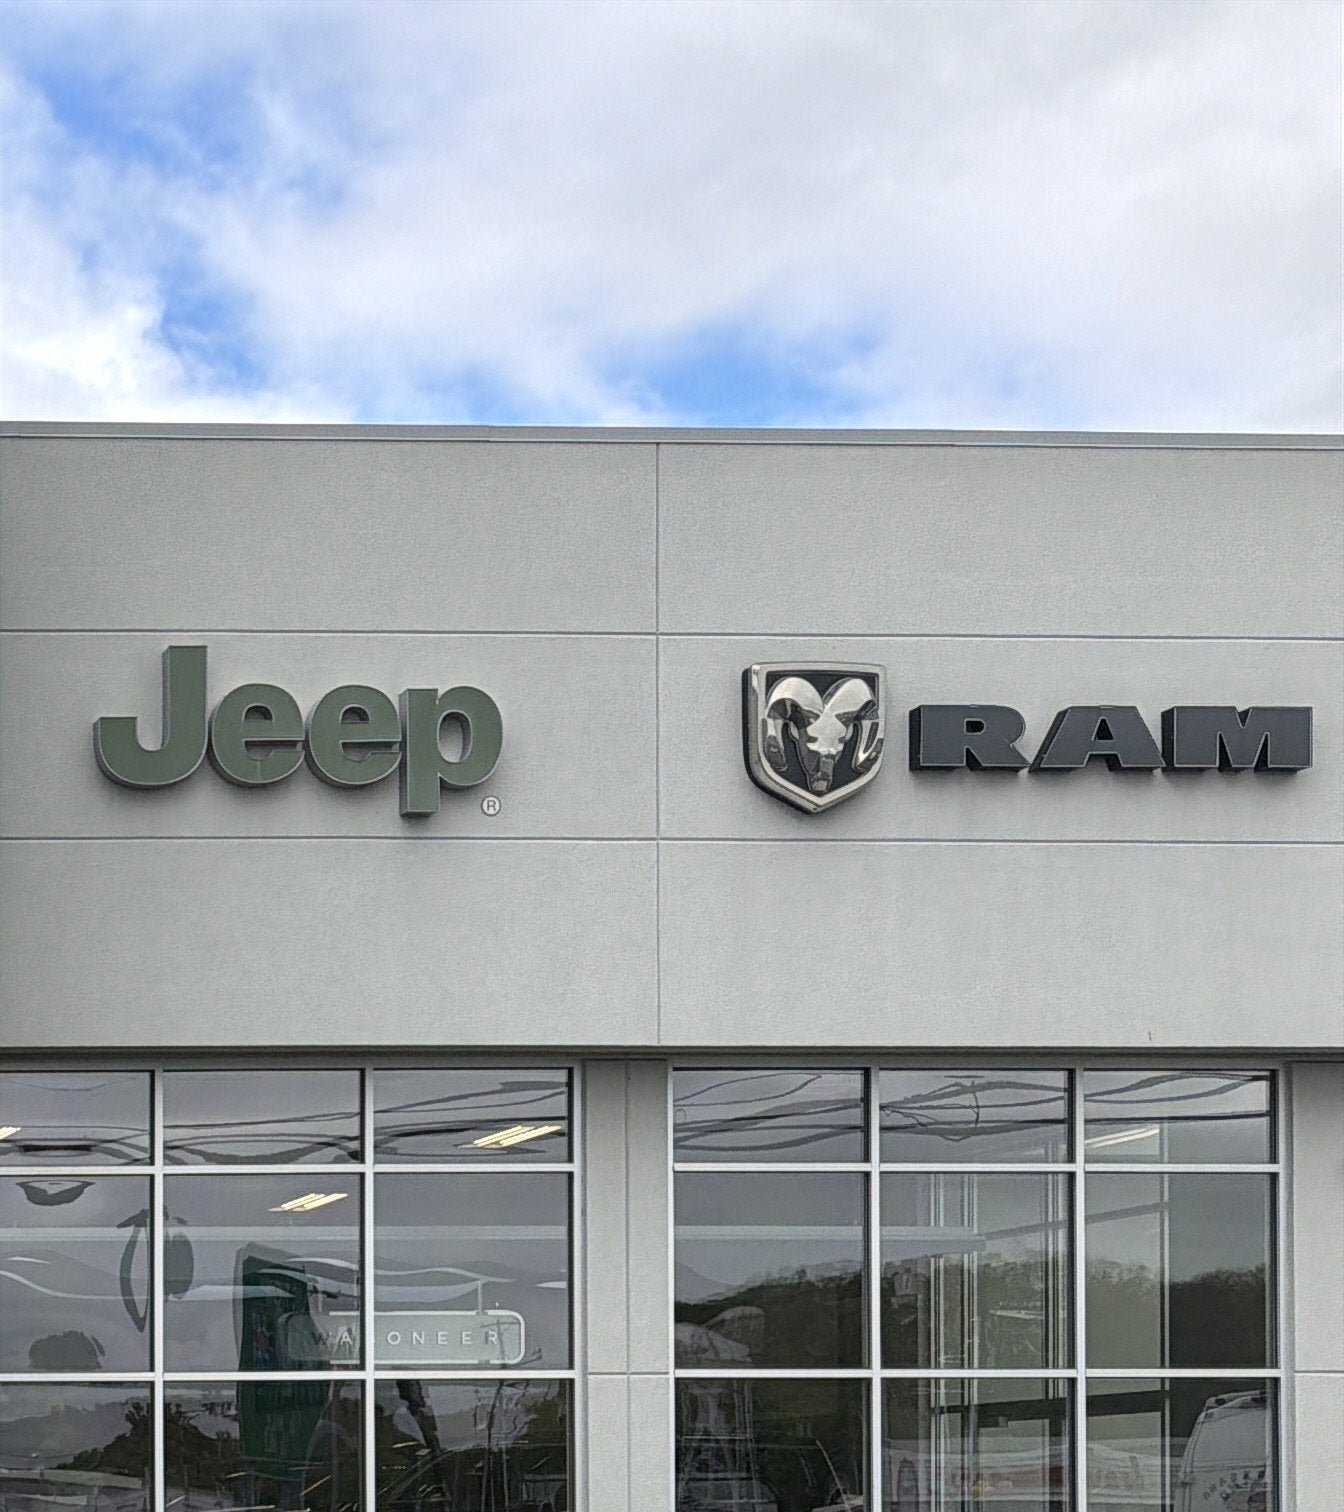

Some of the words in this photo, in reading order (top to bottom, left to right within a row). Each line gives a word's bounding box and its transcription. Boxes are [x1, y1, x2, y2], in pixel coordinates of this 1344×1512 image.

[93, 645, 503, 818] Jeep
[909, 705, 1314, 773] RAM
[315, 1330, 499, 1345] WAONEER
